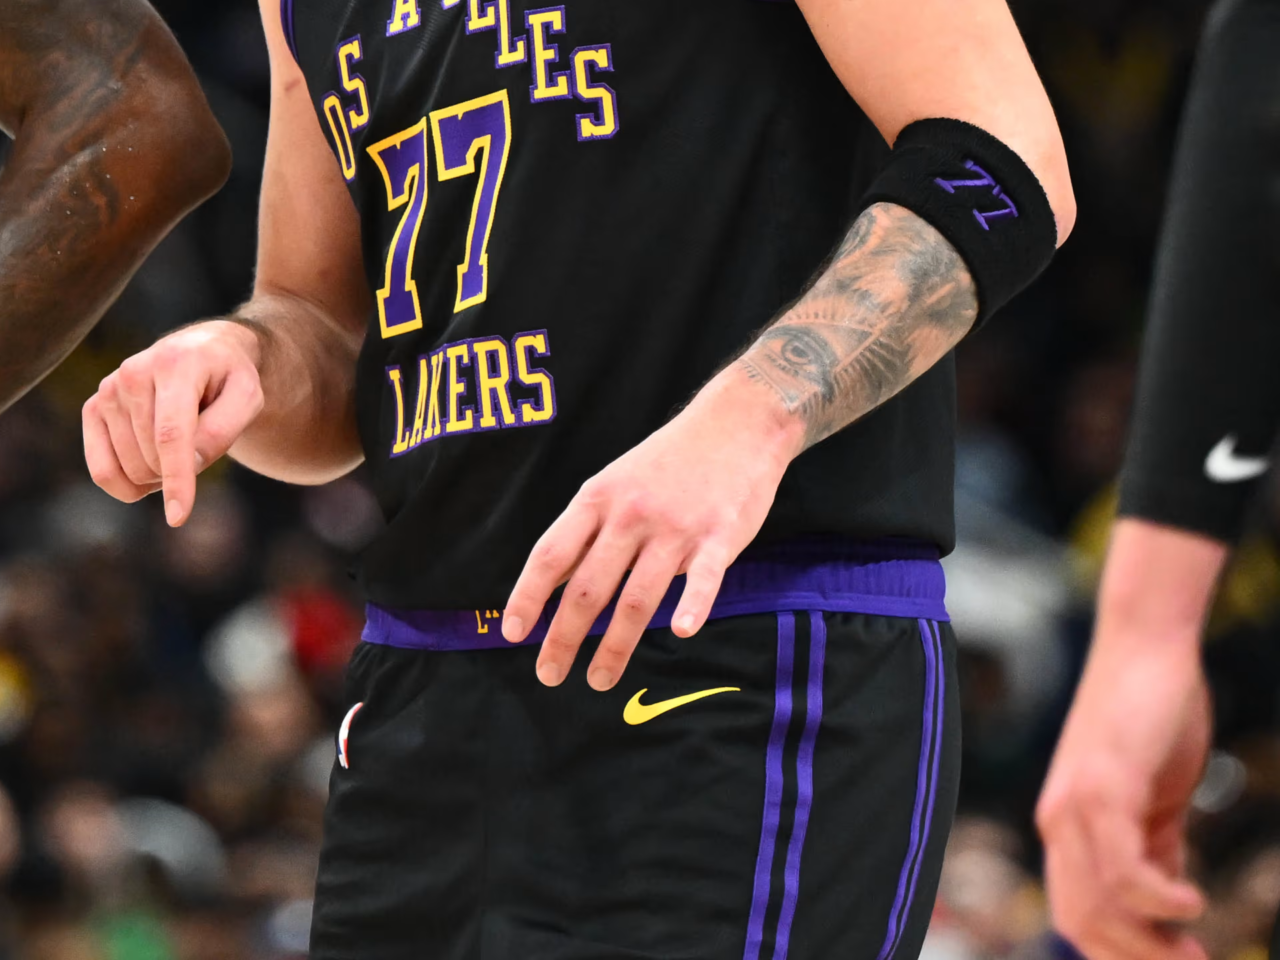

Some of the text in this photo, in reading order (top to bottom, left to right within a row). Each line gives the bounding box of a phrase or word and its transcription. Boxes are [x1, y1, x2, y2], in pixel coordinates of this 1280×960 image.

[321, 34, 370, 183] OS
[366, 88, 512, 339] 77
[934, 159, 1019, 231] 77
[384, 328, 558, 459] LAKERS
